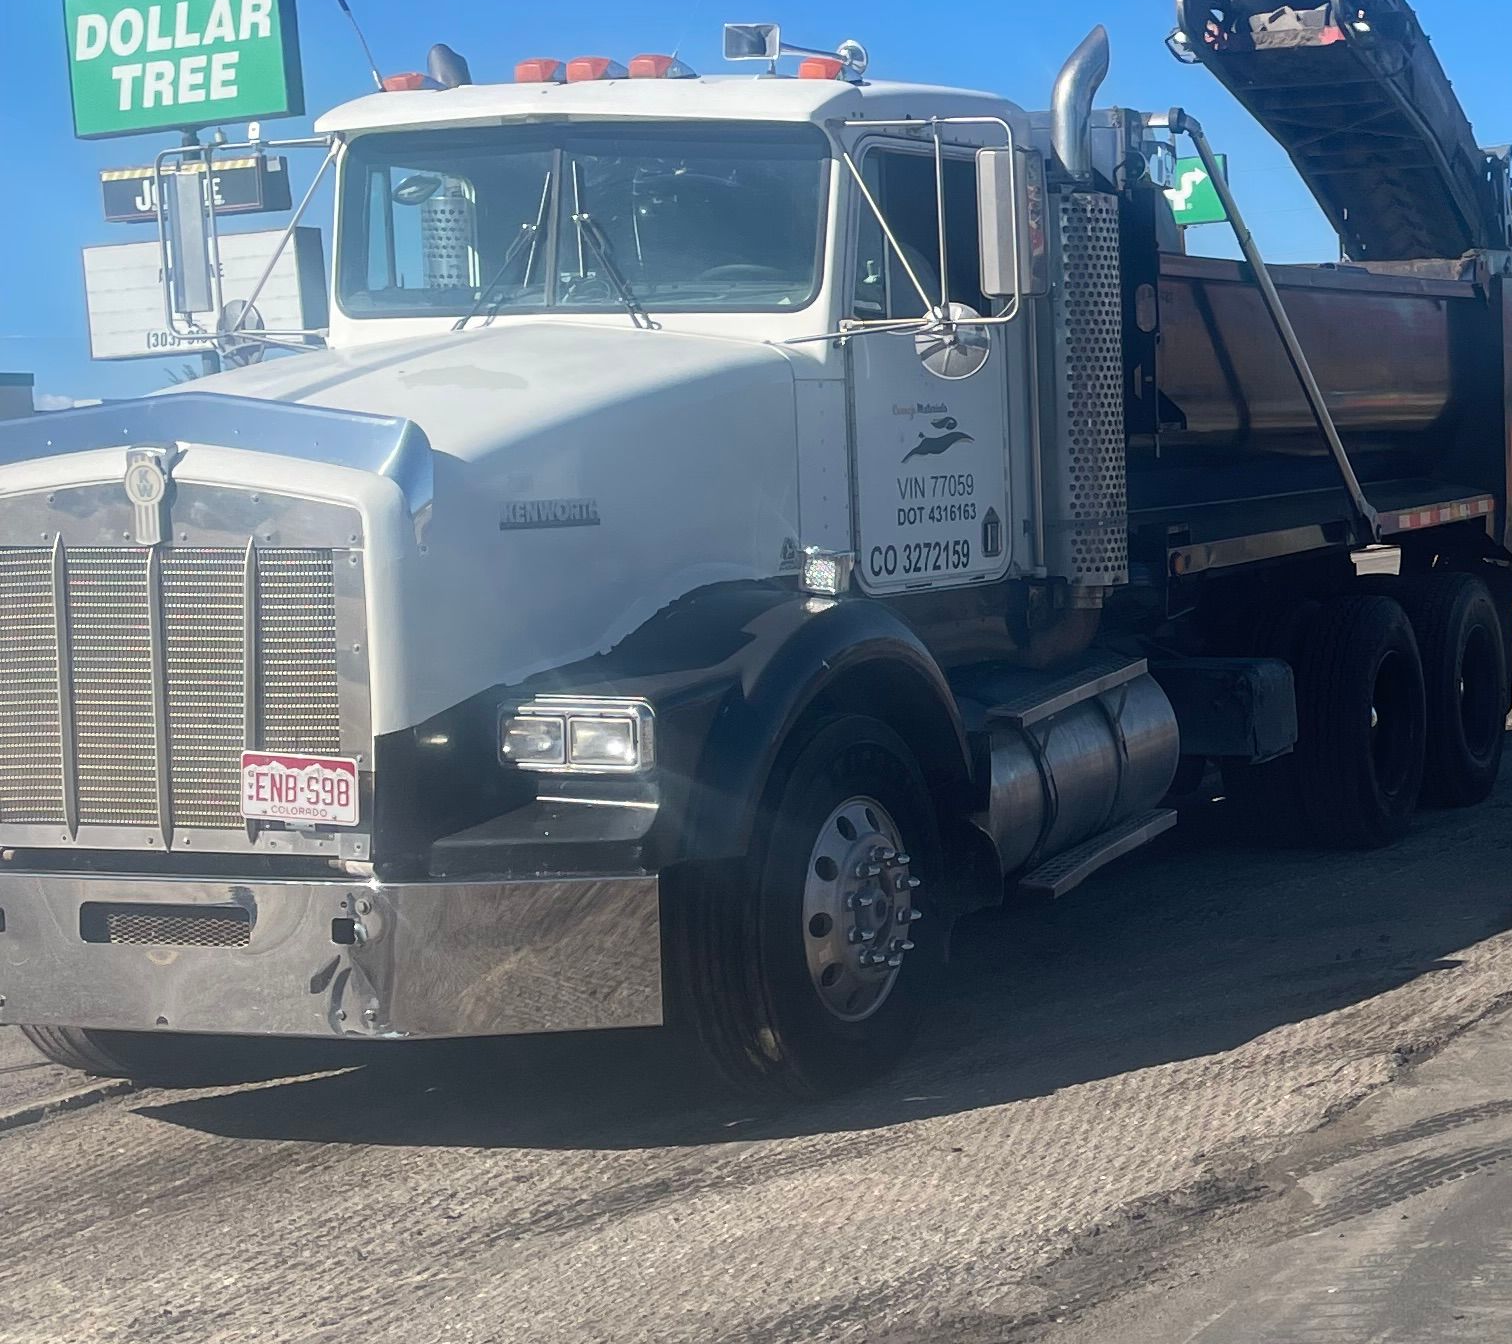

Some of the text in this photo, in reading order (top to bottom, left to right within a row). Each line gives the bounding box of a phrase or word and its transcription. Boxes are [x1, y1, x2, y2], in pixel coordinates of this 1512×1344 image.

[111, 51, 240, 112] TREE
[897, 473, 975, 500] VIN 77059
[897, 502, 977, 526] DOT 4316163
[870, 539, 970, 577] CO 3272159
[270, 804, 328, 818] COLORADO
